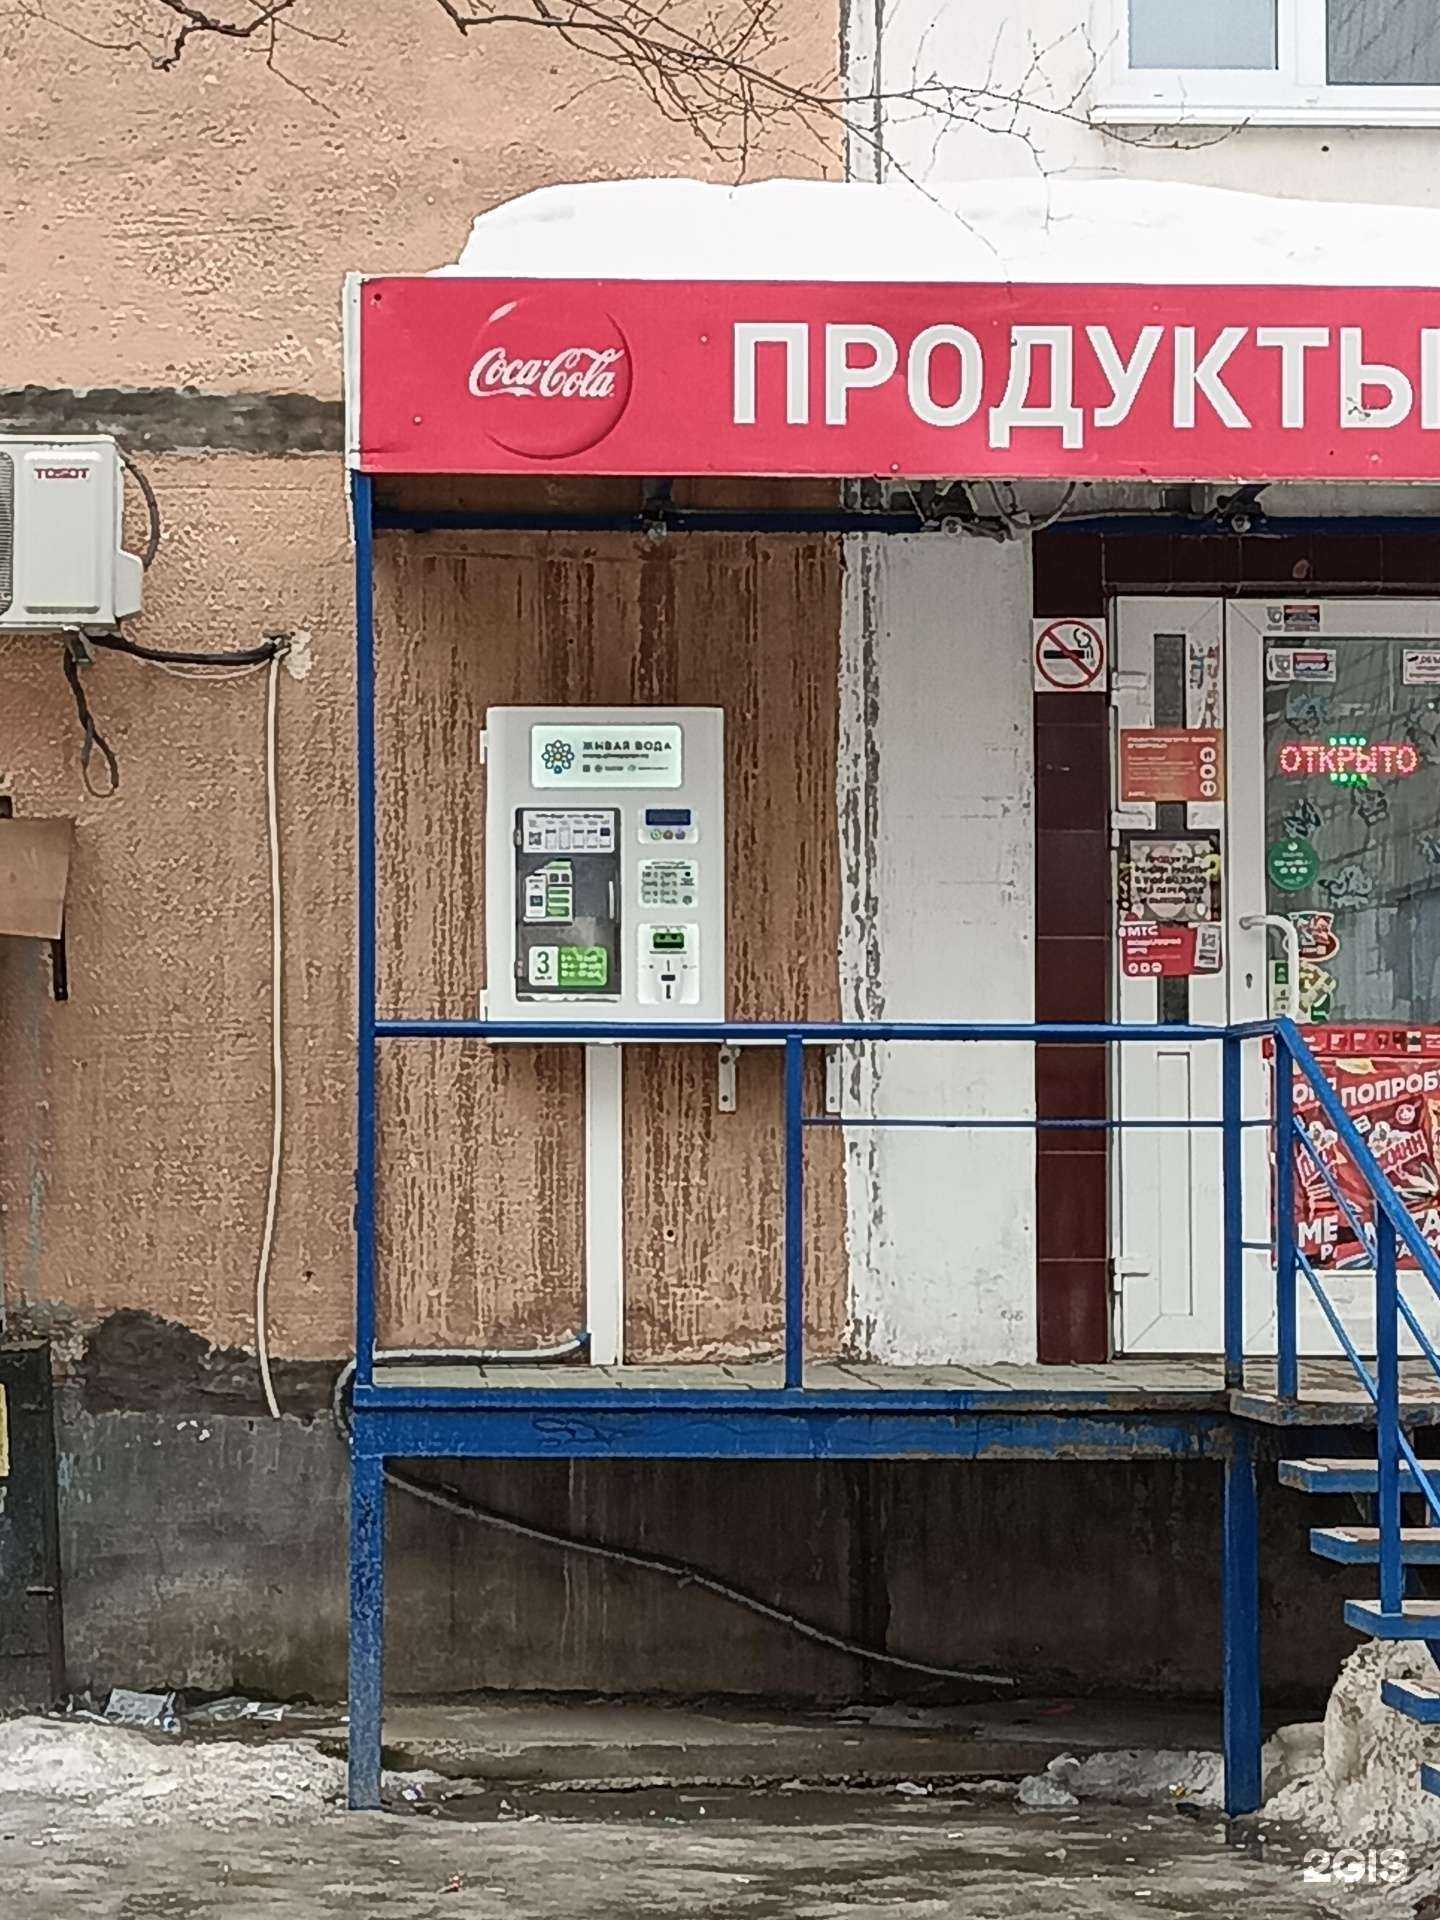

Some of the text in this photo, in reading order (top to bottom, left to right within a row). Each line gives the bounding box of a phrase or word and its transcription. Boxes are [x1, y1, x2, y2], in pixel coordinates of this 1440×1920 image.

[469, 347, 625, 397] Coca-Cola
[734, 322, 1440, 448] ПРОДУКТЫ
[34, 468, 90, 480] TOSOT
[635, 741, 672, 752] ВОДА
[1280, 746, 1418, 773] ОТКРЫТО
[536, 951, 550, 974] 3
[1341, 1069, 1440, 1108] ПОПРОБ
